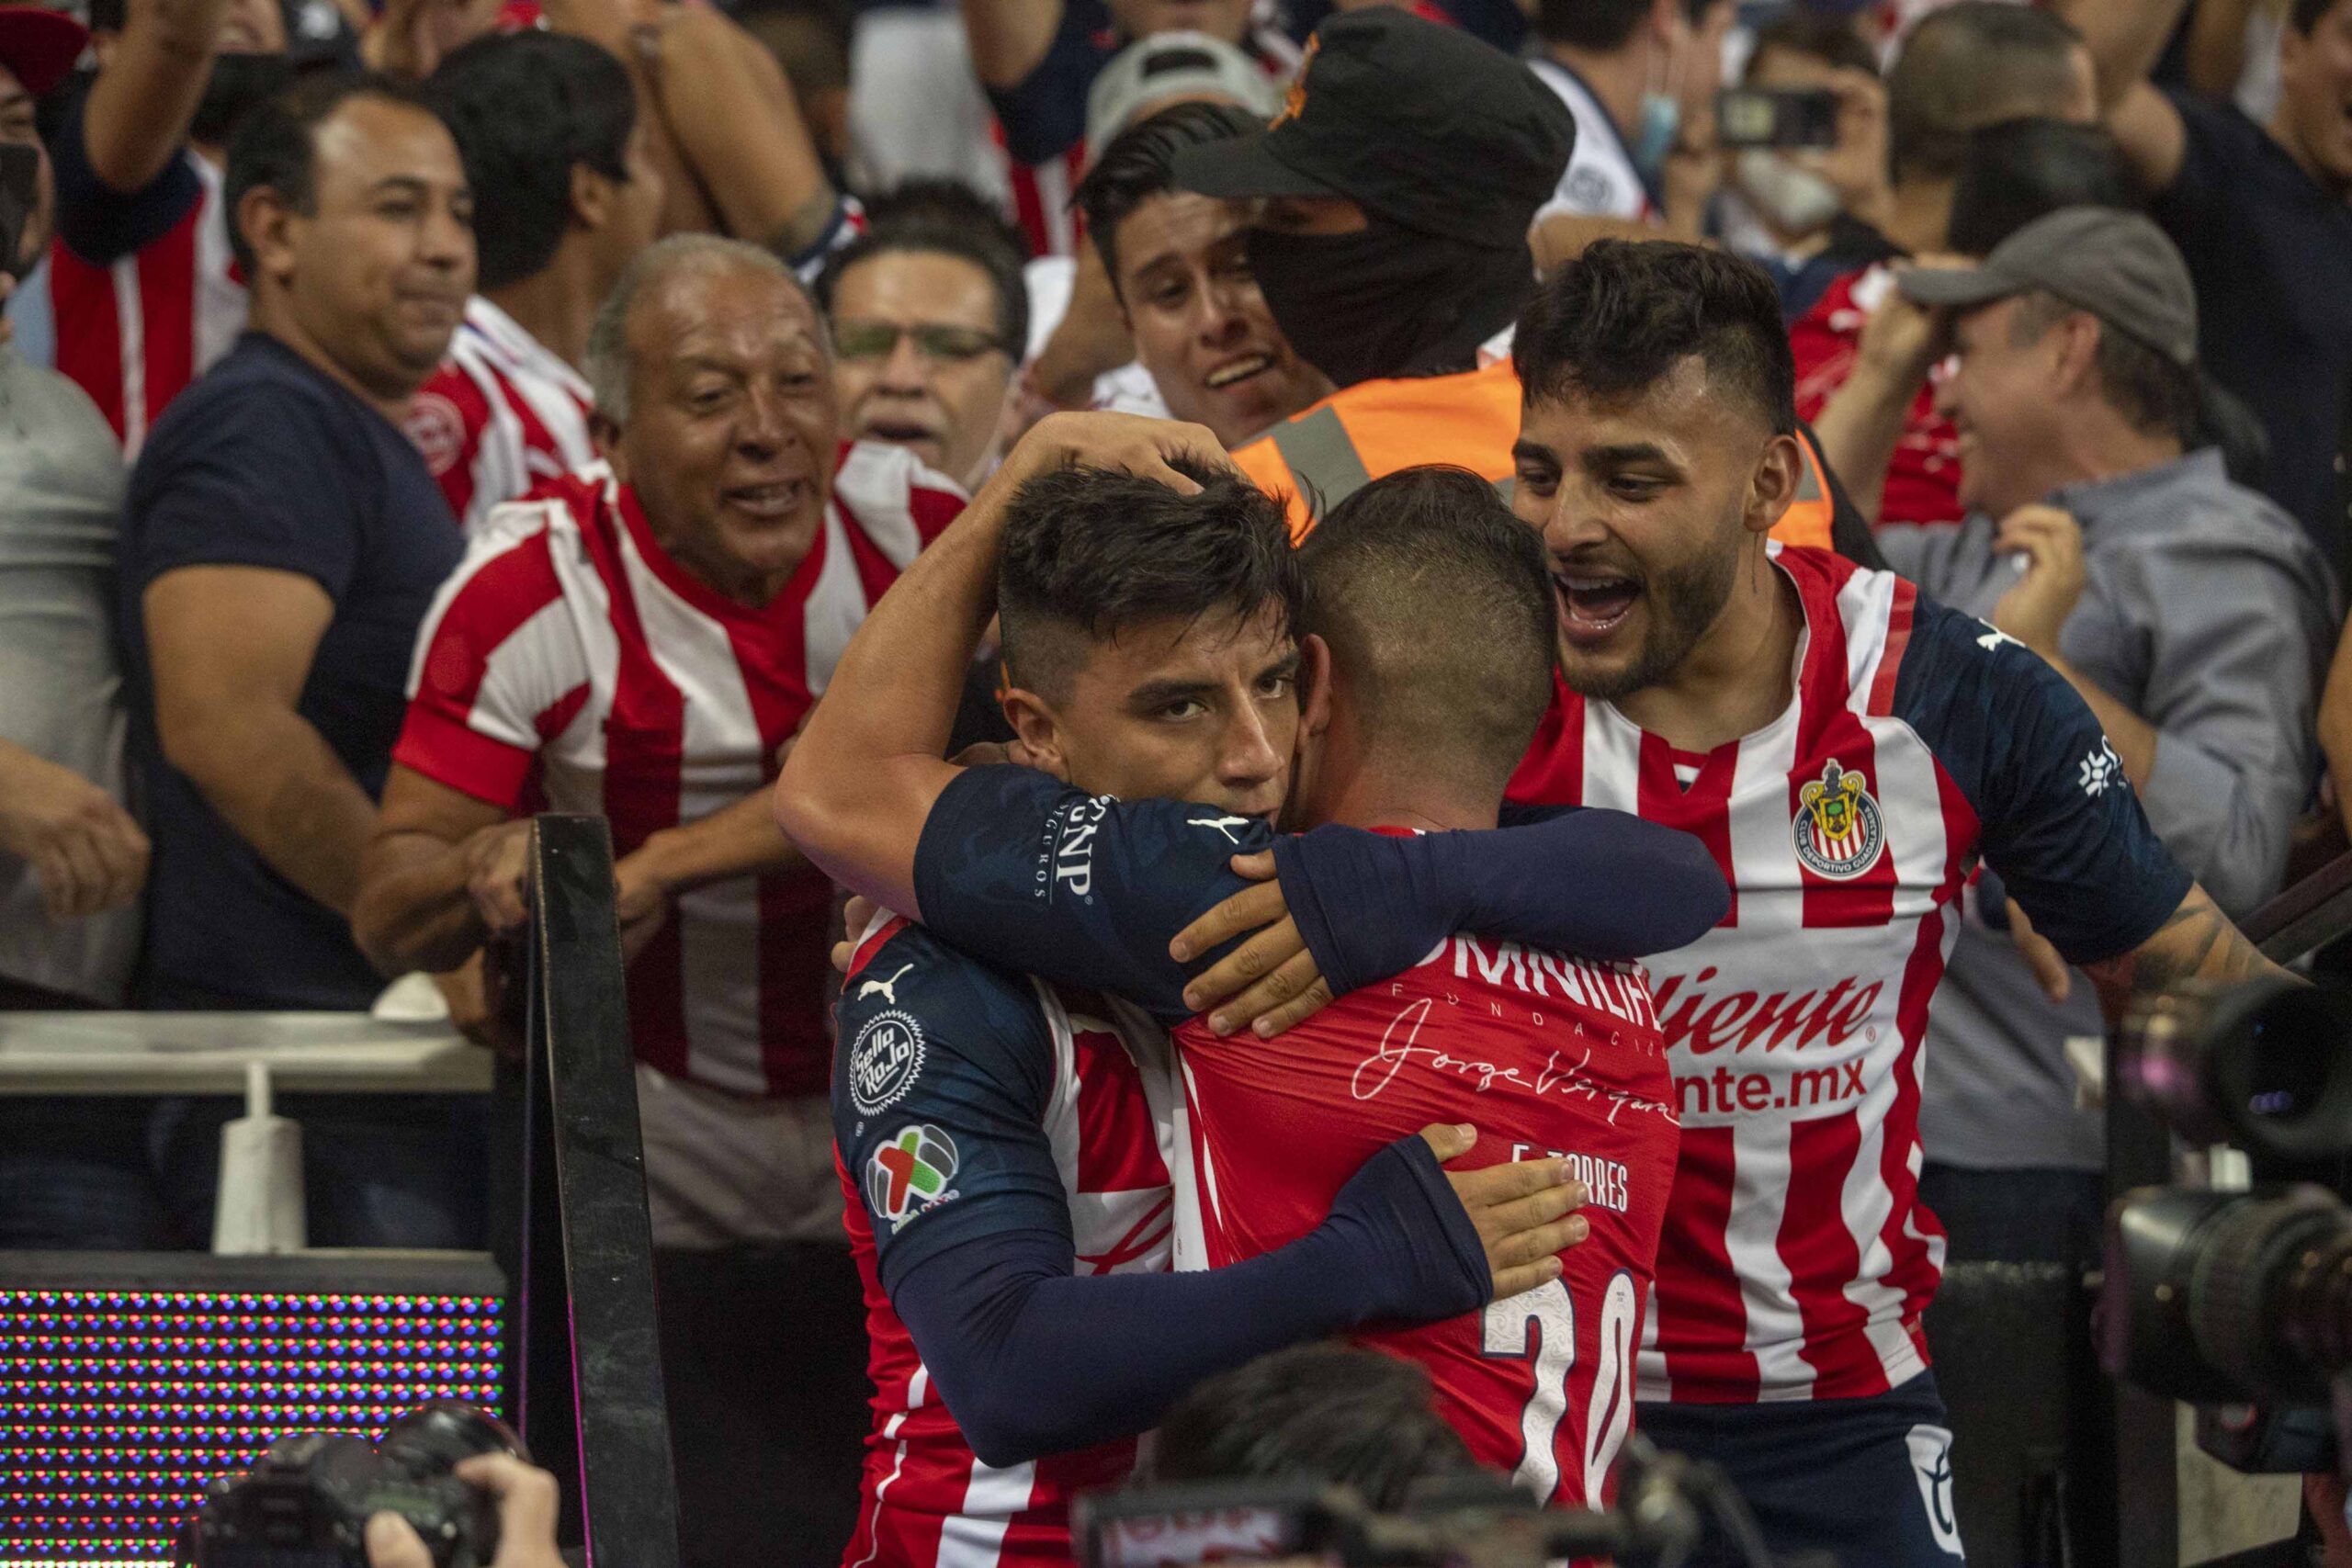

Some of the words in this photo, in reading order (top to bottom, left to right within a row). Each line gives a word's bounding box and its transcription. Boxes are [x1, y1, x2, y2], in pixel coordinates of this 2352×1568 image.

[1799, 820, 1808, 845] CLUB
[1804, 845, 1852, 873] DEPORTIVO
[1852, 806, 1877, 868] GUADALAJARA
[1416, 932, 1662, 1032] MNILIFE
[1655, 966, 1883, 1055] liente
[855, 1028, 895, 1082] Sello
[1351, 997, 1532, 1100] Jorge
[1675, 1058, 1867, 1113] nte.mx
